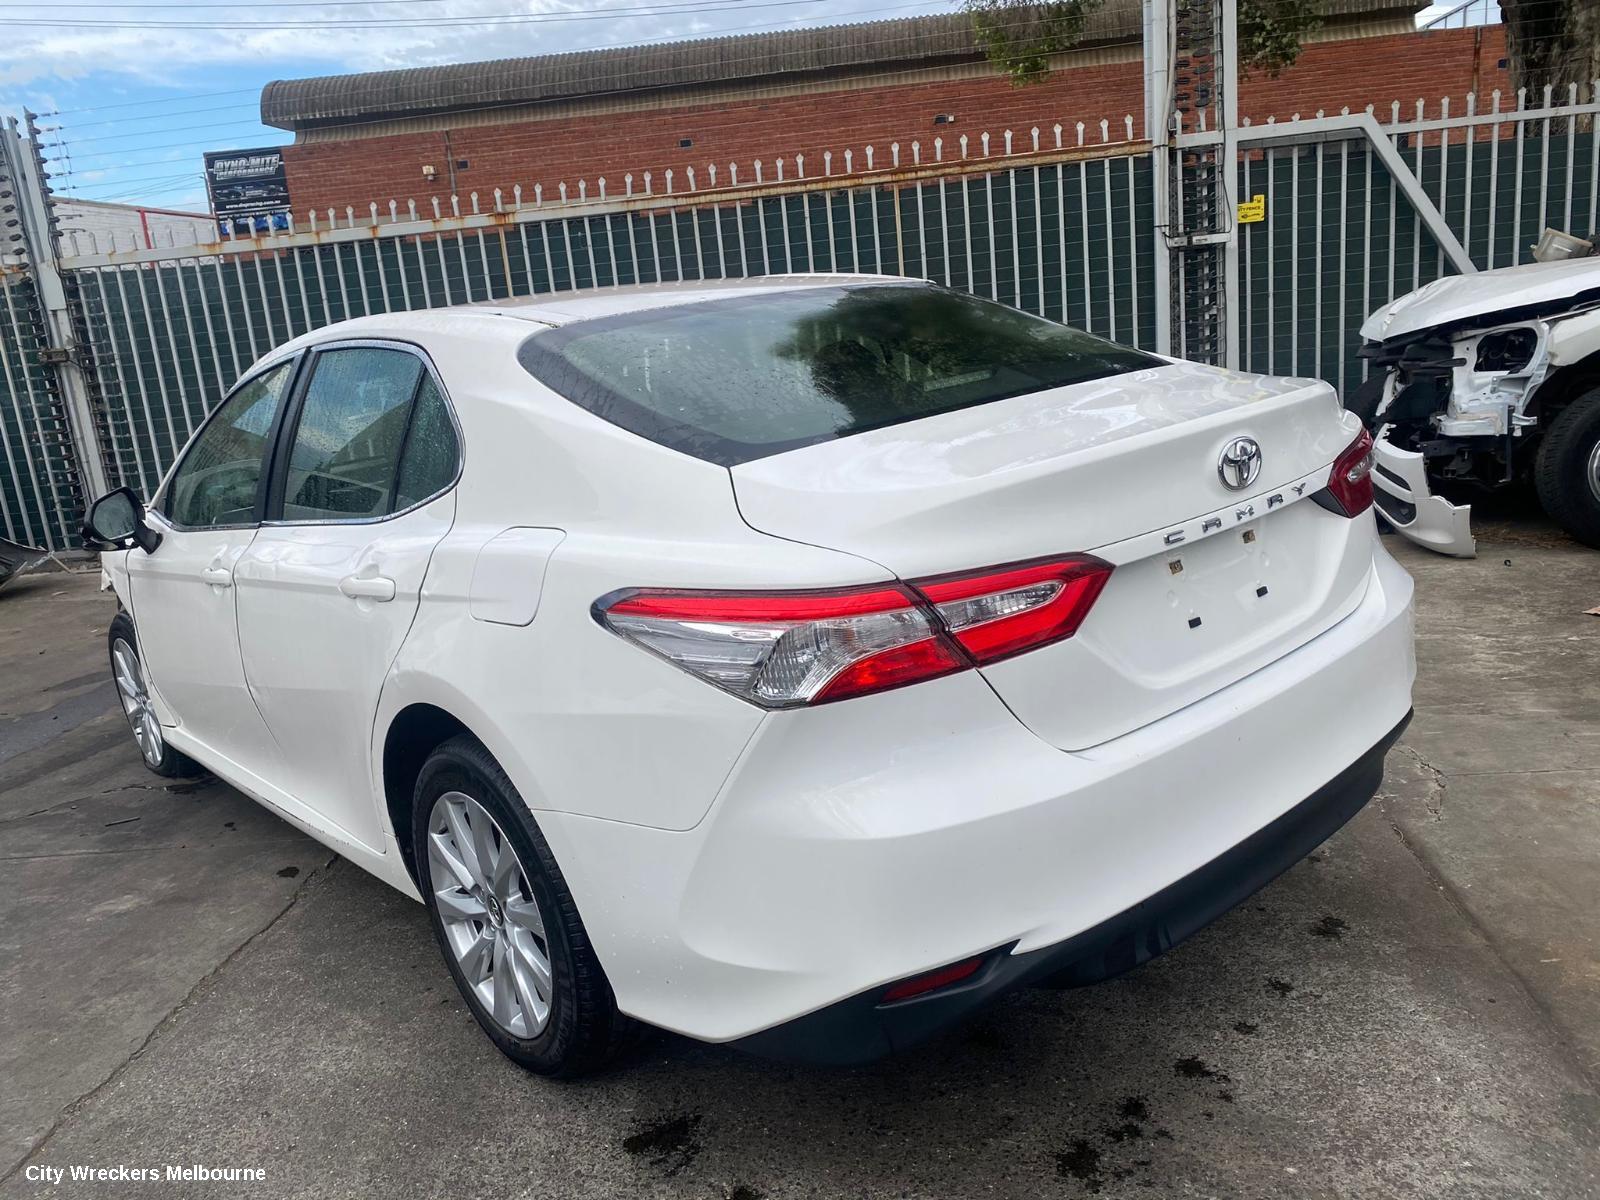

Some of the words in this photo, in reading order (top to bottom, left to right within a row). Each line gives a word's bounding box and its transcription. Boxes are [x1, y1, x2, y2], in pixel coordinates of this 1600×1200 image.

[215, 156, 278, 173] DYNO-MITE
[218, 166, 275, 178] PERFORMANCE
[1163, 482, 1306, 546] CAMRY
